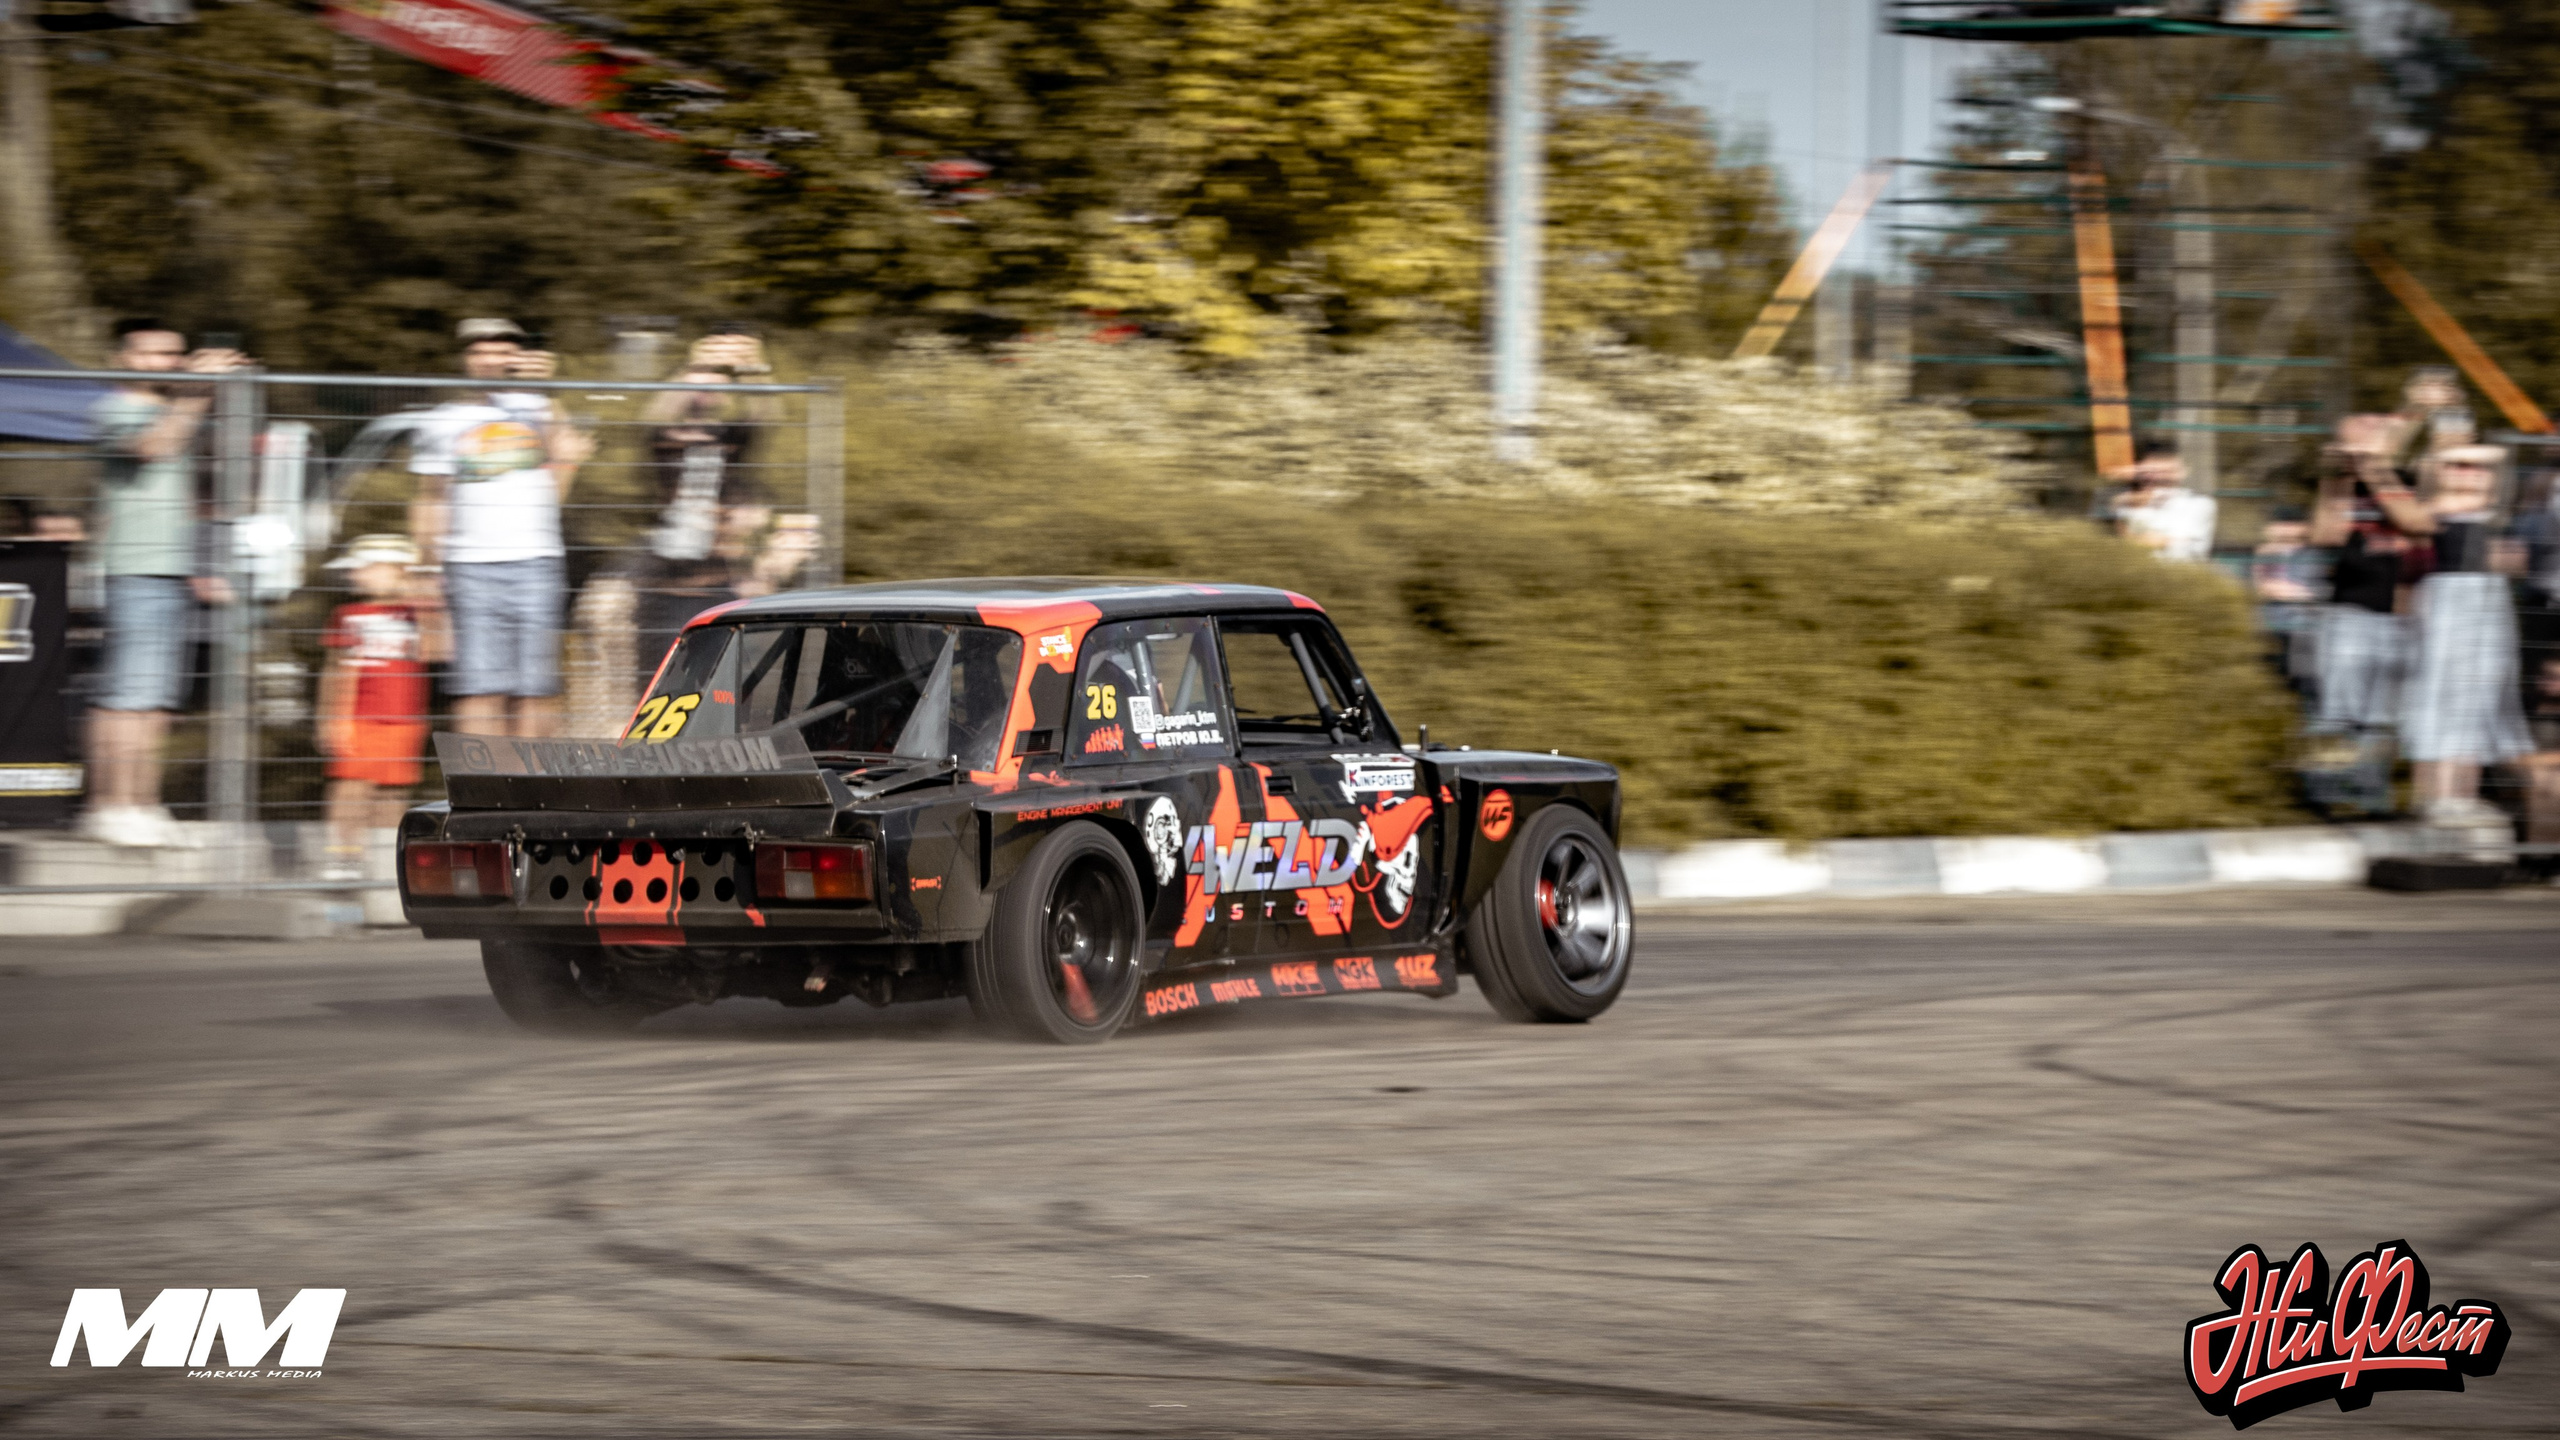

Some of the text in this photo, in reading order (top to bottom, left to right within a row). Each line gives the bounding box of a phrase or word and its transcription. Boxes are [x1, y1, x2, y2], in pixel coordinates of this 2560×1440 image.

[1086, 684, 1117, 720] 26
[622, 692, 701, 746] 26
[1156, 731, 1198, 748] ПЕТРОВ
[1017, 798, 1124, 822] ENGINE MANAGEMENT UNIT
[1180, 898, 1345, 924] USTOM
[1271, 964, 1321, 986] HKS
[1336, 960, 1376, 980] NGK
[1394, 953, 1439, 980] 1UZ
[1145, 982, 1200, 1017] BOSCH
[1210, 978, 1262, 1003] MAHLE
